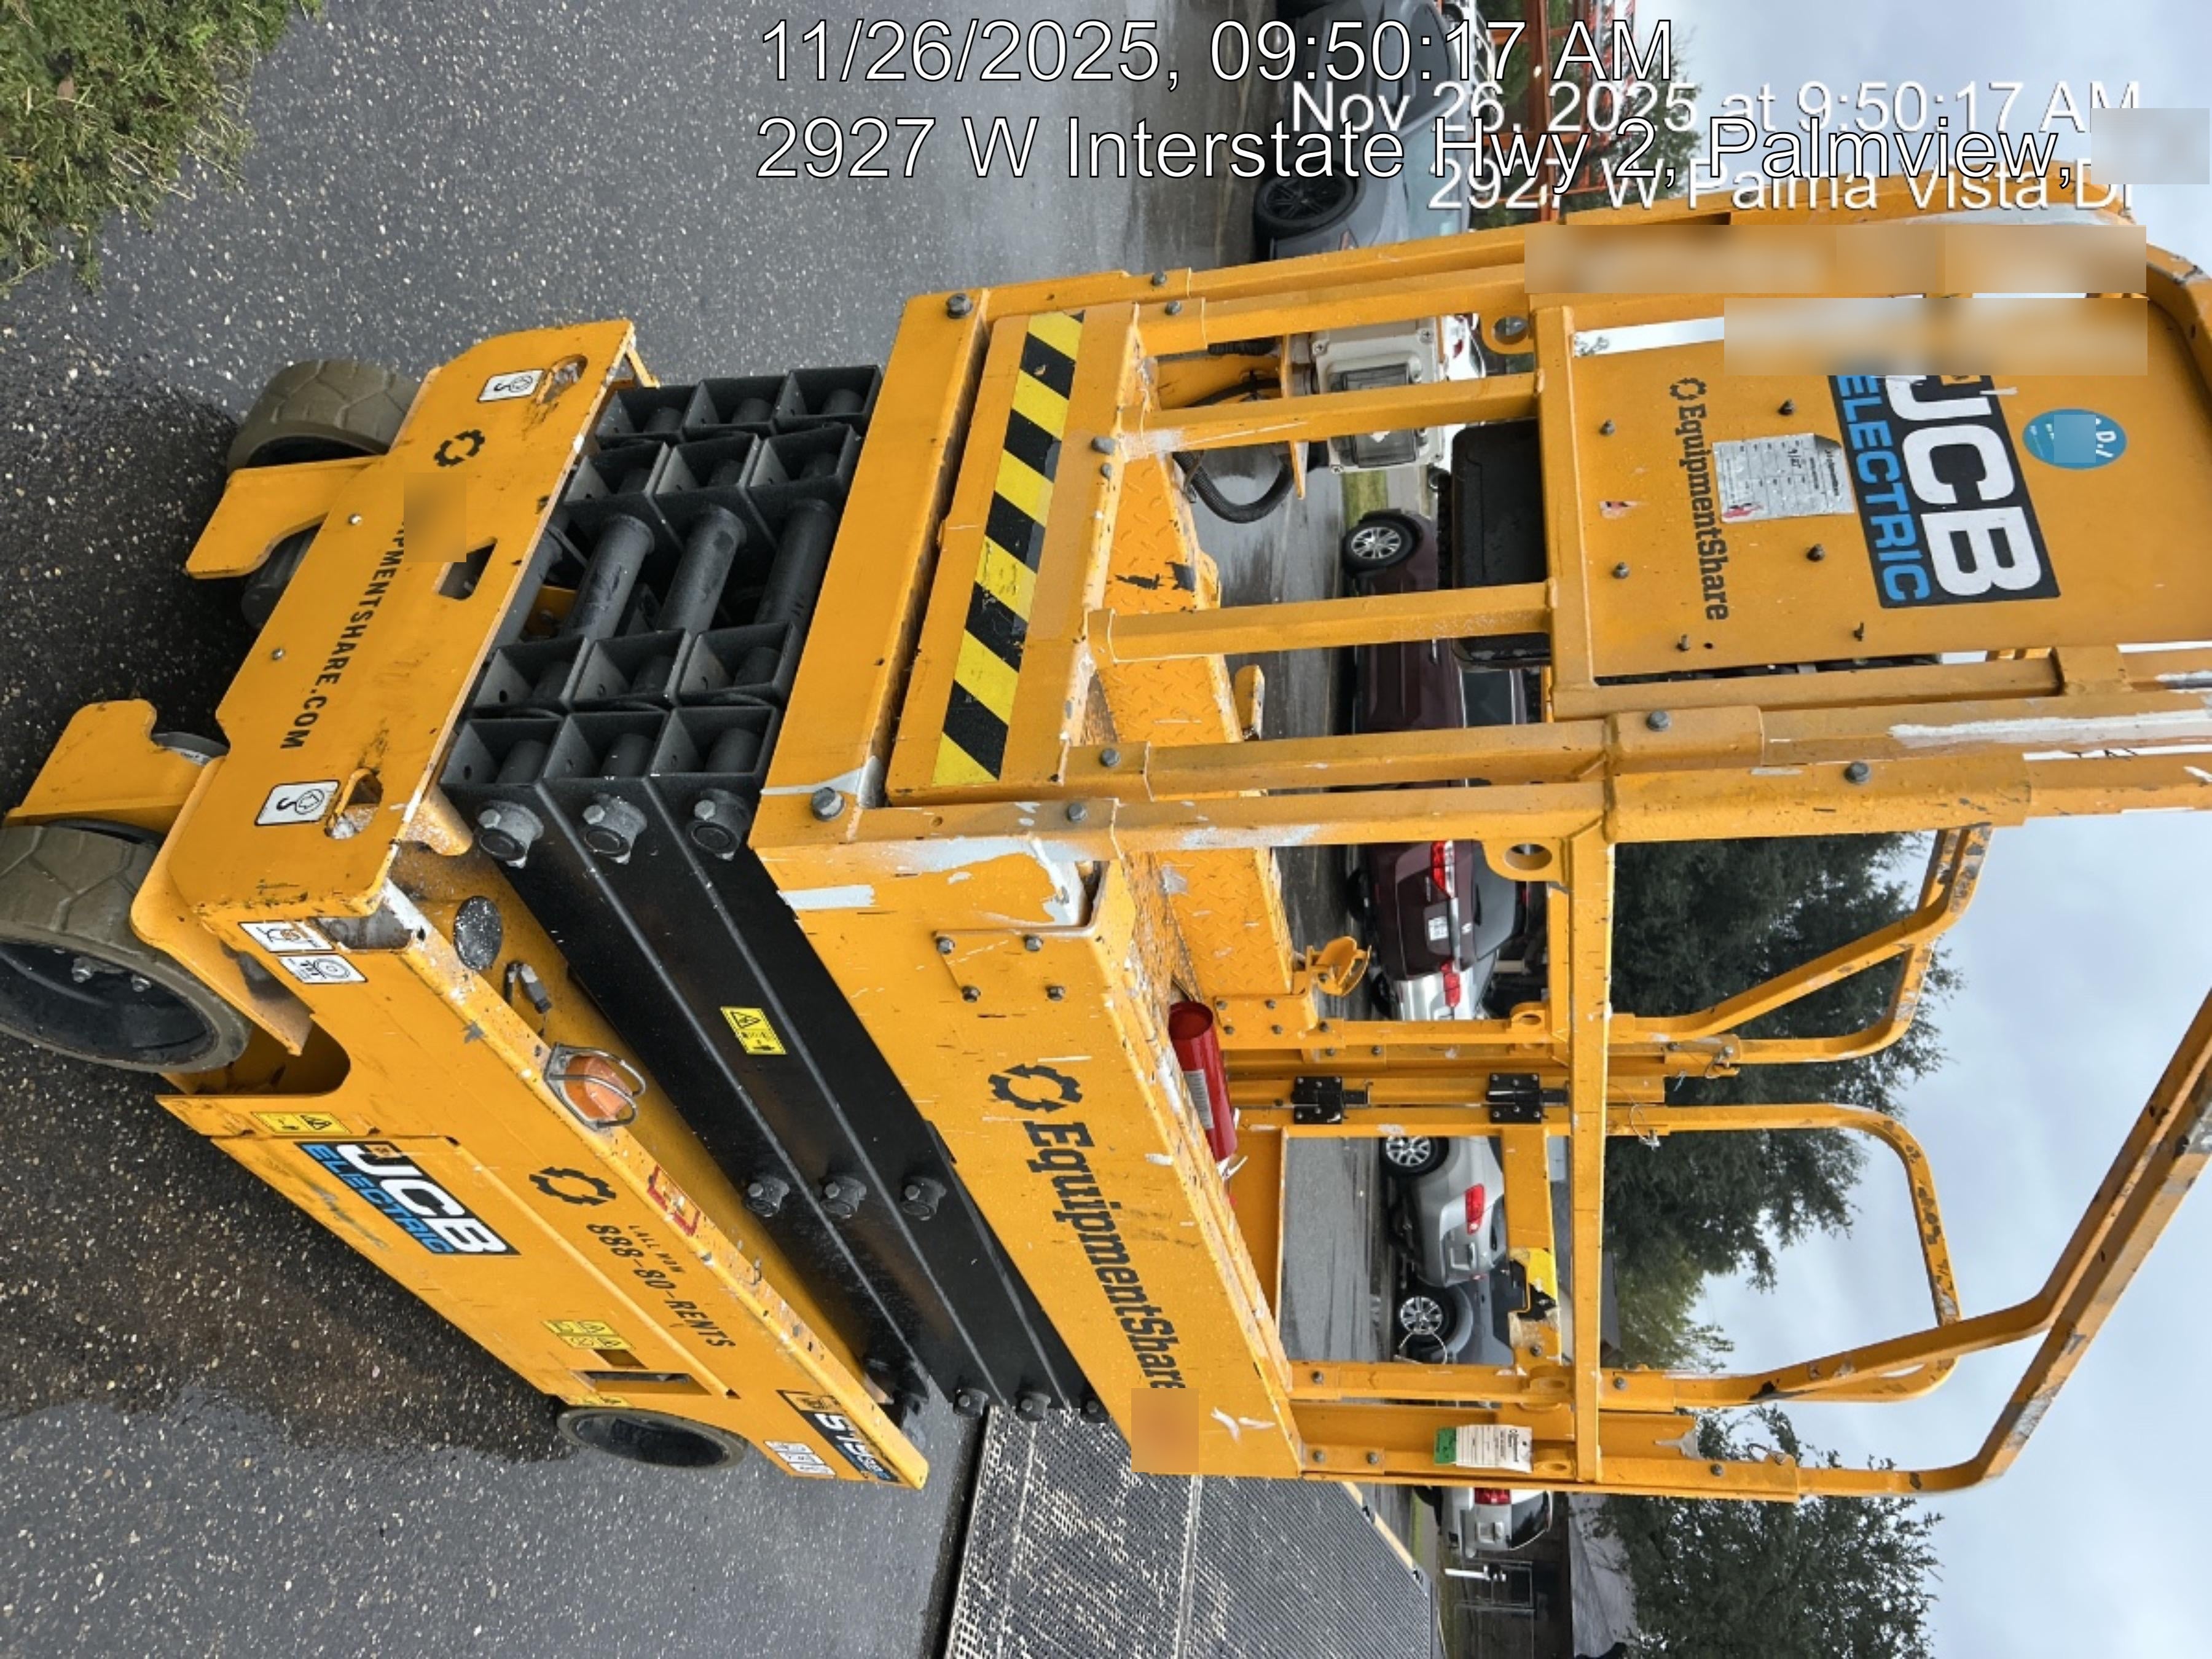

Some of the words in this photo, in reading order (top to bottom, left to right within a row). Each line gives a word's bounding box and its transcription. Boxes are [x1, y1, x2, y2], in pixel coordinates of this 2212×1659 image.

[1677, 405, 1728, 621] EquipmentShare
[1885, 375, 2041, 596] JCB
[300, 1144, 454, 1252] ELECTRIC
[336, 1144, 506, 1252] JCB
[585, 1223, 736, 1347] 888-80-RENTS
